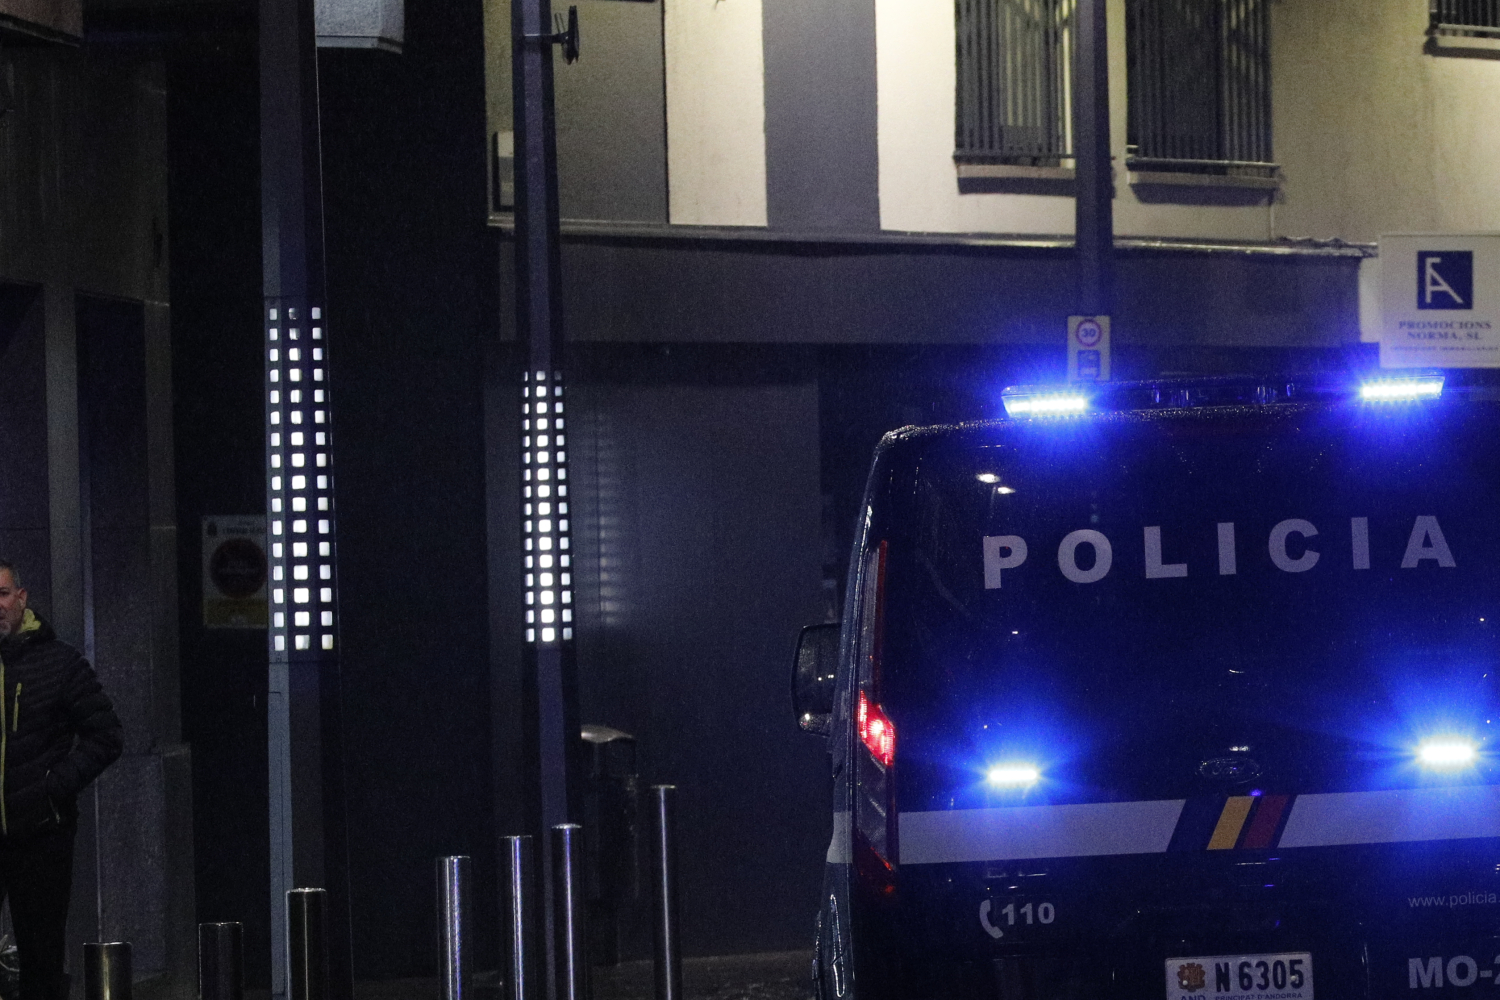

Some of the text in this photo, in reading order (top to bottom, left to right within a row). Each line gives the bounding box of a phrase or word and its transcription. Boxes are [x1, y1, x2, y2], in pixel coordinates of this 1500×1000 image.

[1081, 328, 1096, 337] 30
[1399, 320, 1492, 330] PROMOCIONS
[983, 515, 1456, 589] POLICIA
[1002, 902, 1055, 926] 110
[1214, 958, 1304, 993] N 6305
[1257, 992, 1303, 1000] D'ANDORRA
